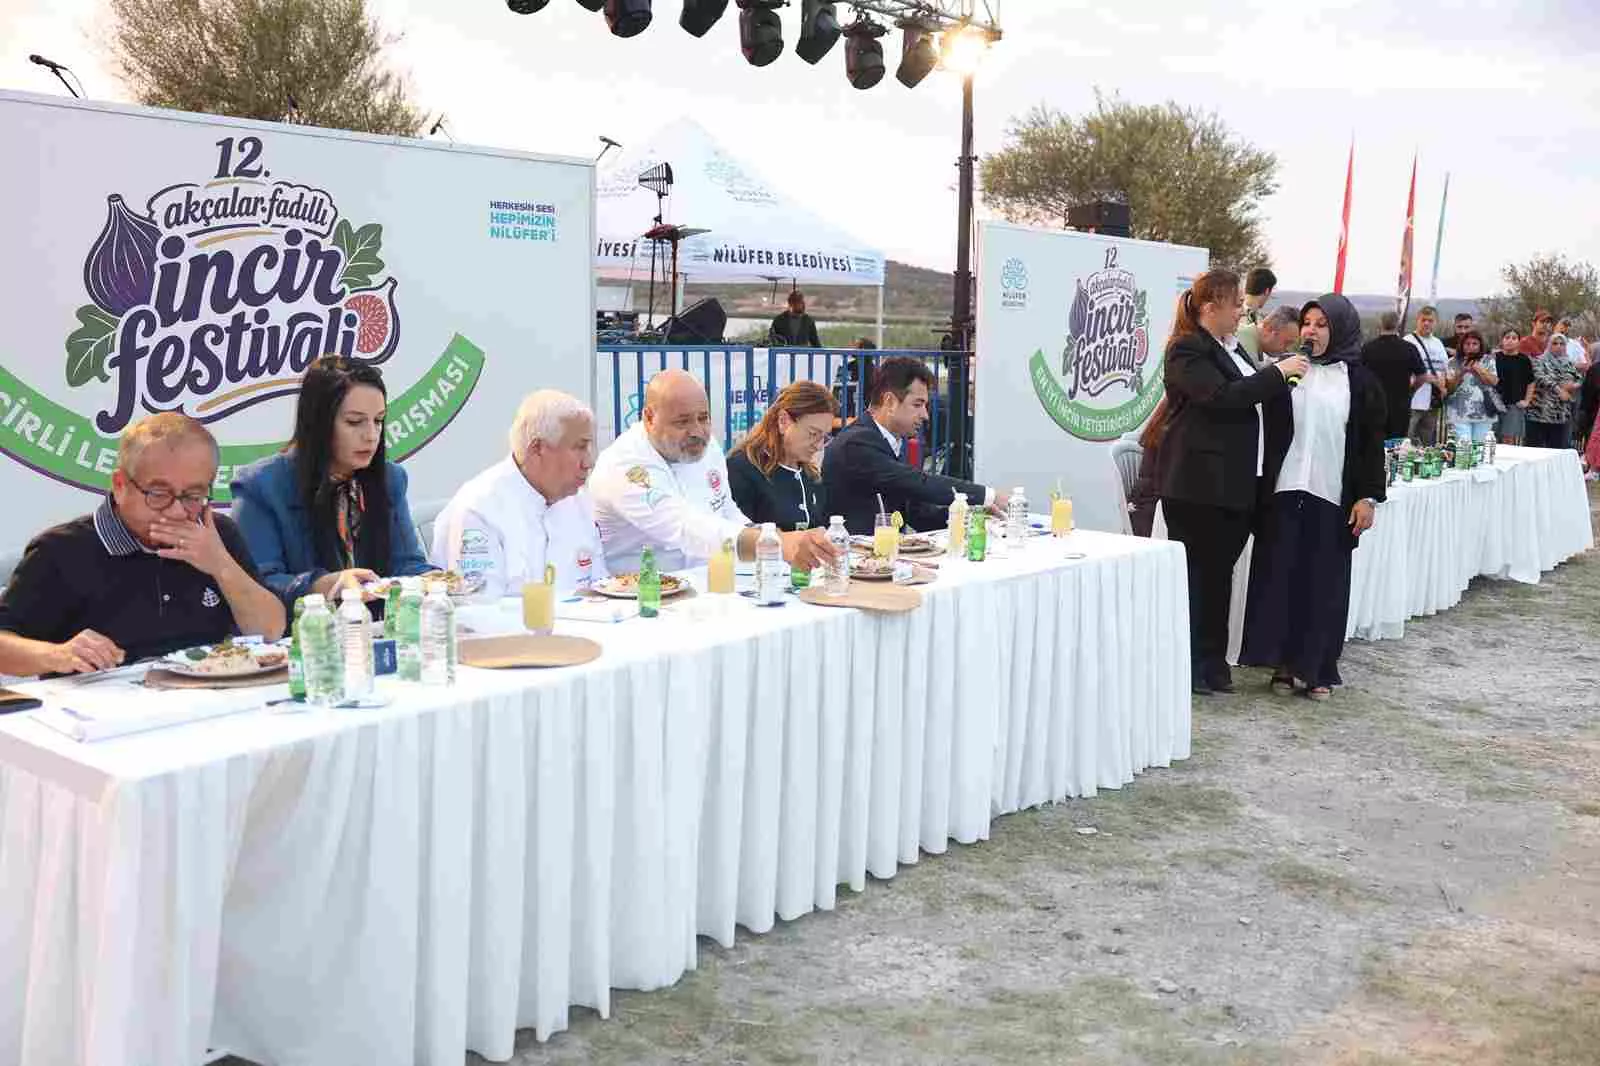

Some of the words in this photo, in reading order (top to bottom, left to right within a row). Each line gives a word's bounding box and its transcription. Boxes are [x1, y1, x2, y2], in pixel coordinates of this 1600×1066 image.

[214, 136, 271, 179] 12.
[489, 200, 534, 211] HERKESİN
[490, 212, 556, 227] HEPİMİZİN
[154, 229, 346, 328] incir
[713, 244, 774, 265] NİLÜFER
[778, 251, 852, 273] BELEDİYESİ
[1086, 294, 1136, 346] incir
[96, 307, 358, 433] festivali
[1068, 336, 1137, 400] festivali
[385, 354, 470, 449] RIŞMASI
